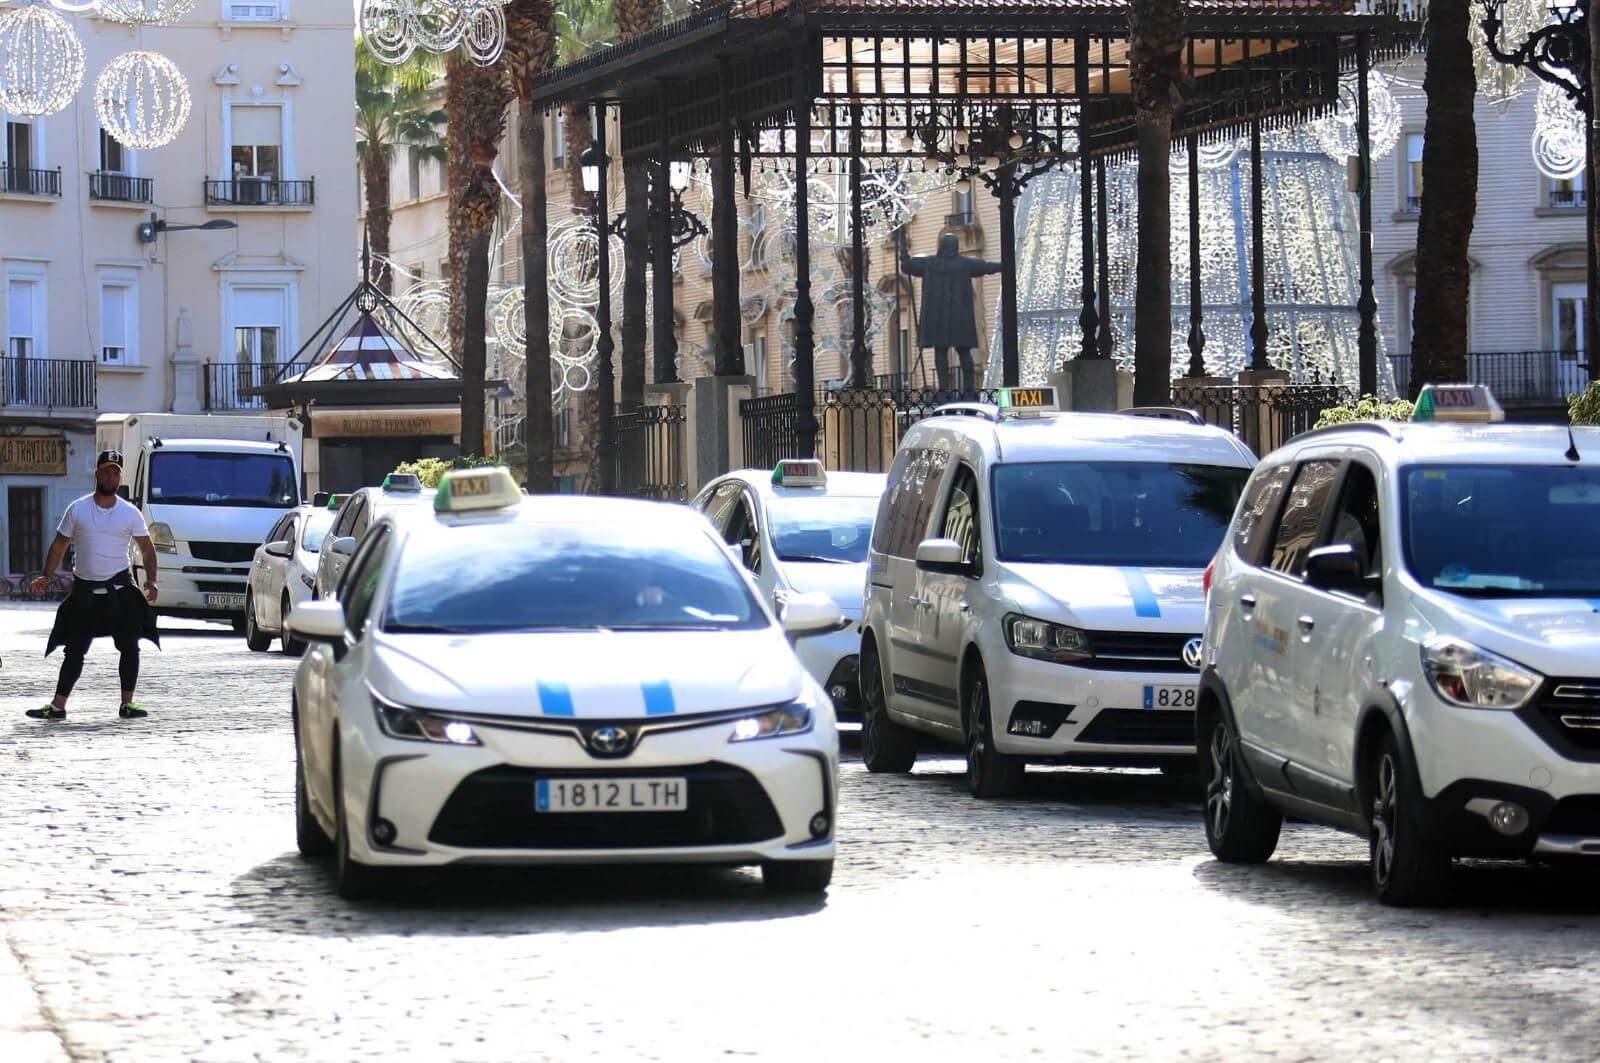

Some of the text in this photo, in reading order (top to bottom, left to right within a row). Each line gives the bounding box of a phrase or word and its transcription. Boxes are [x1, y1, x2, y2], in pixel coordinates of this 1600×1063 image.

[1012, 390, 1042, 406] TAXI
[1435, 390, 1472, 405] TAXI
[384, 417, 431, 433] FERNANDO
[16, 440, 57, 463] TRAVIESA
[452, 478, 486, 497] TAXI
[1158, 688, 1196, 707] 828
[556, 782, 680, 807] 1812 LTH
